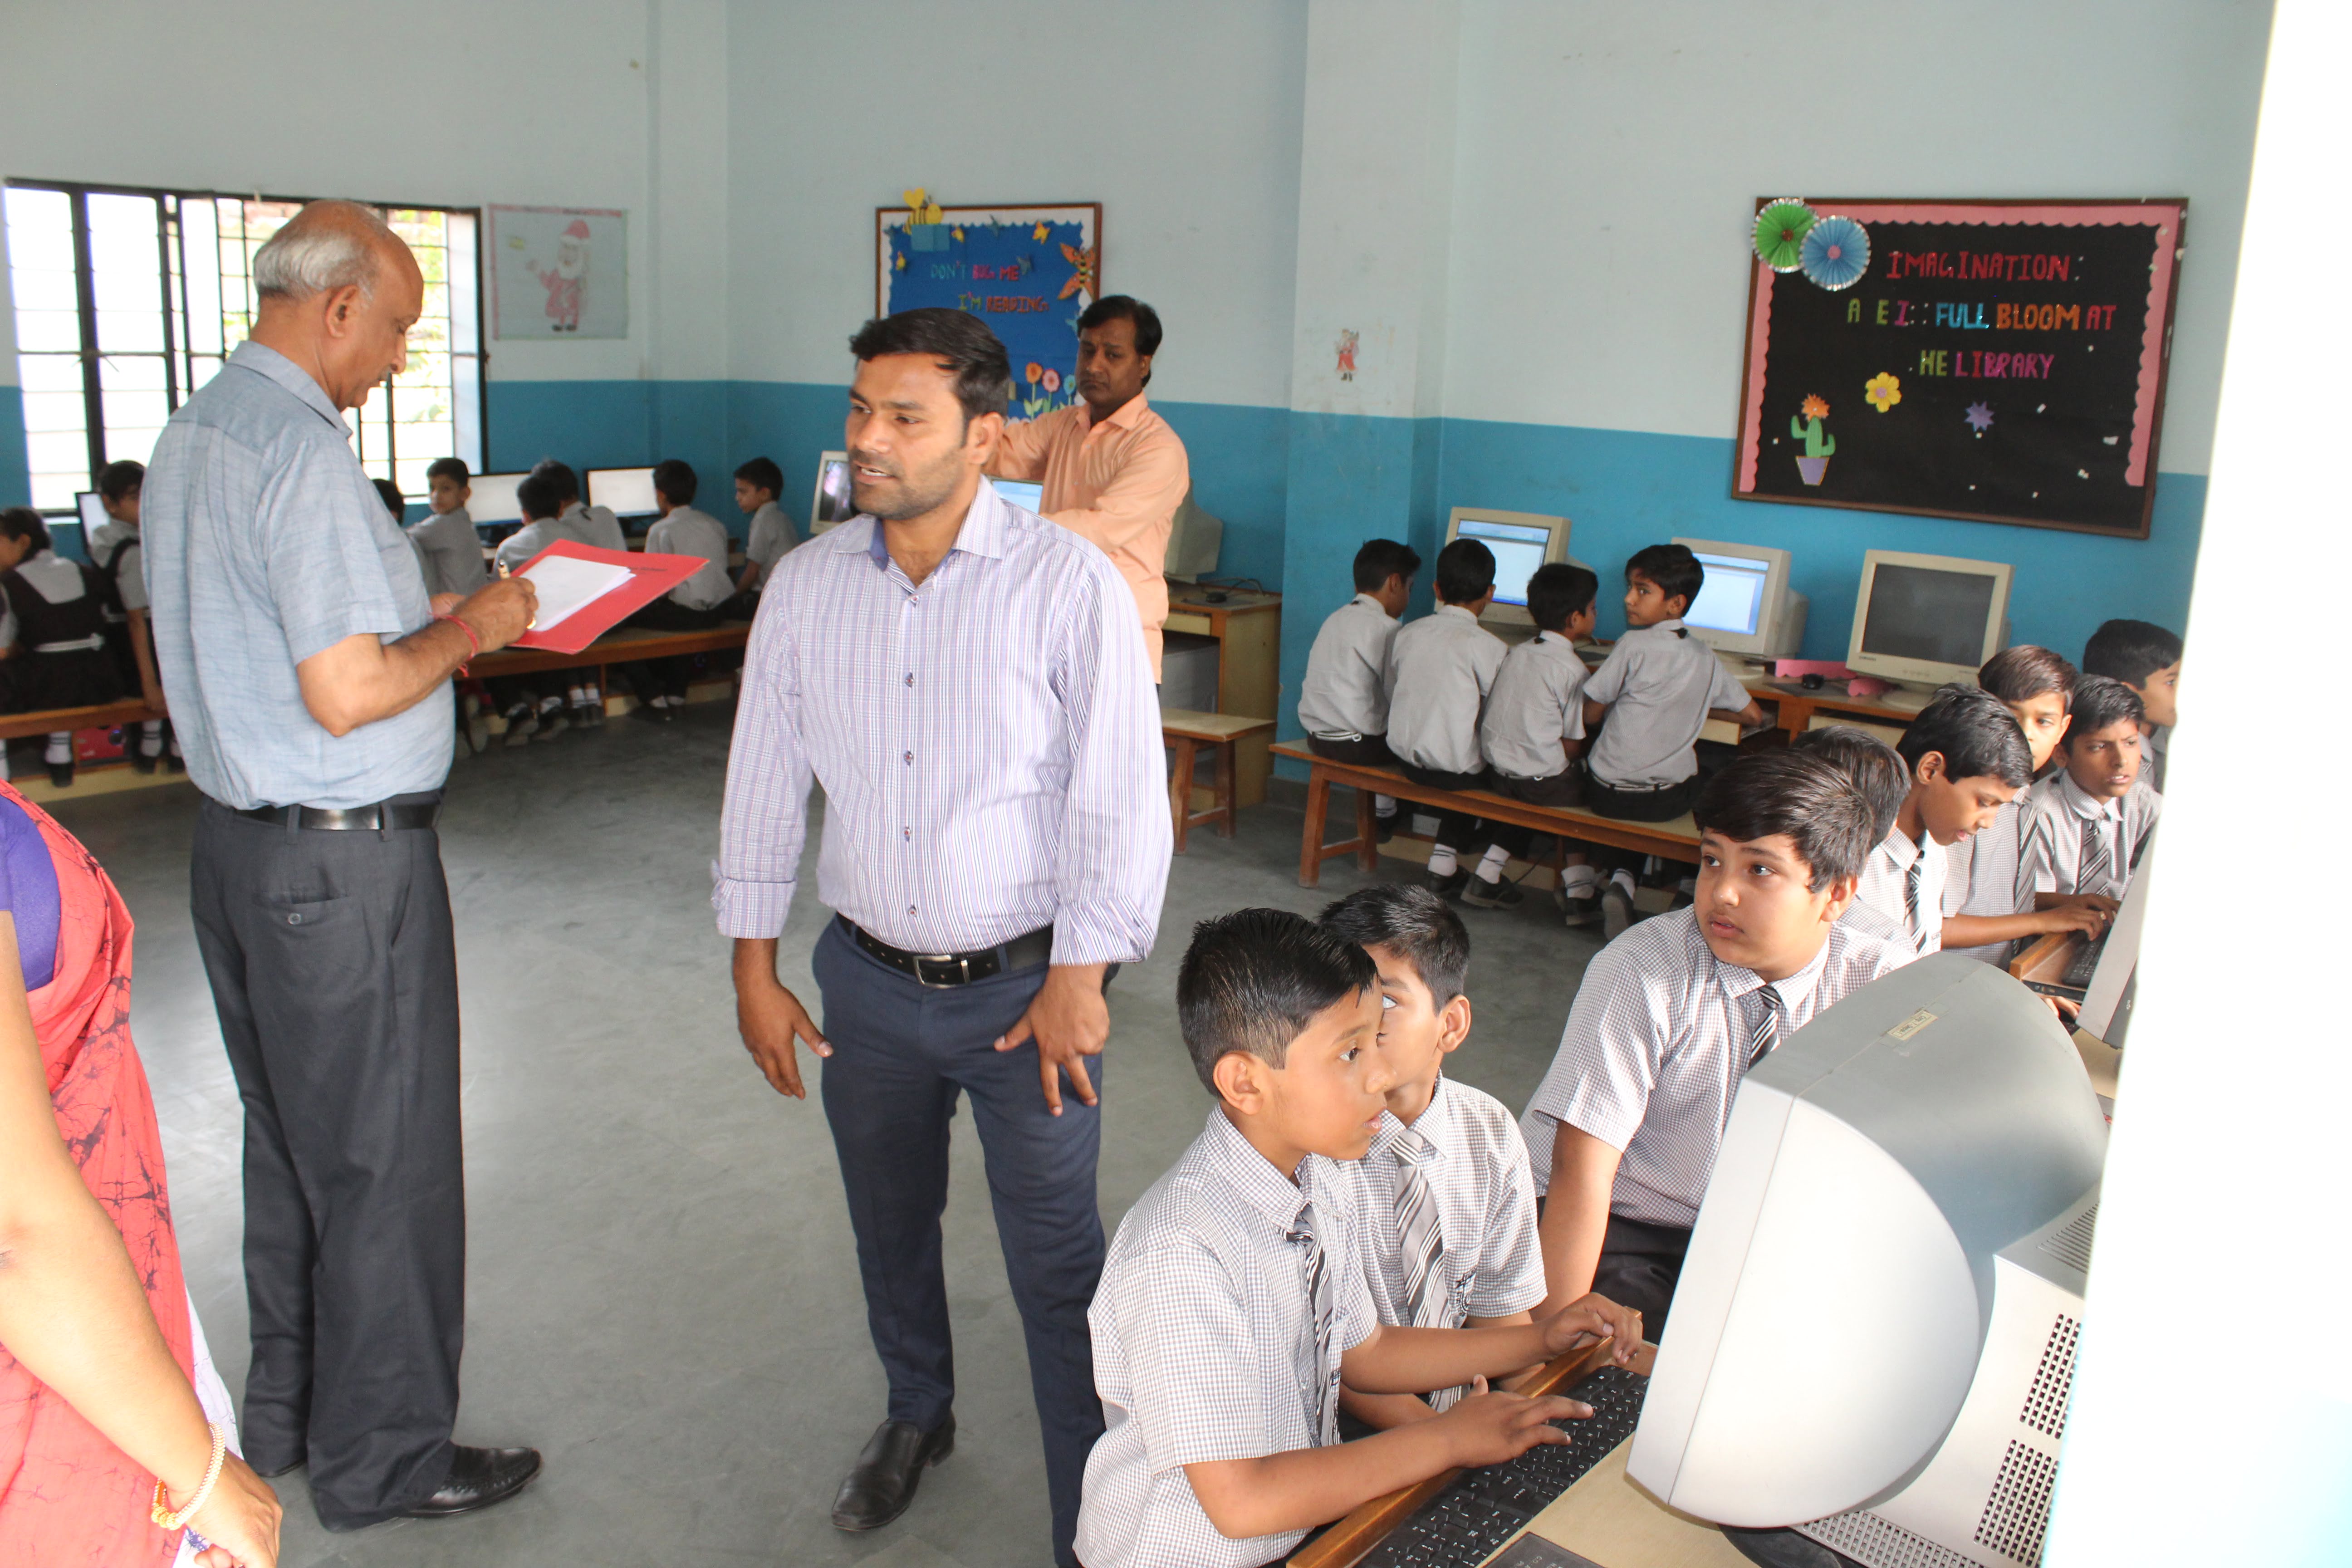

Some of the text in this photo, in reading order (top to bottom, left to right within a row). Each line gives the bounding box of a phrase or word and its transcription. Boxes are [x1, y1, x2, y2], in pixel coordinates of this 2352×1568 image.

[931, 260, 966, 280] DON'T
[999, 265, 1019, 281] ME
[958, 291, 1050, 313] I'M READING
[1936, 303, 1989, 329] FULL
[1996, 303, 2081, 331] BLOOM
[2086, 304, 2117, 330] AT
[1919, 349, 2055, 379] HE LIBRARY
